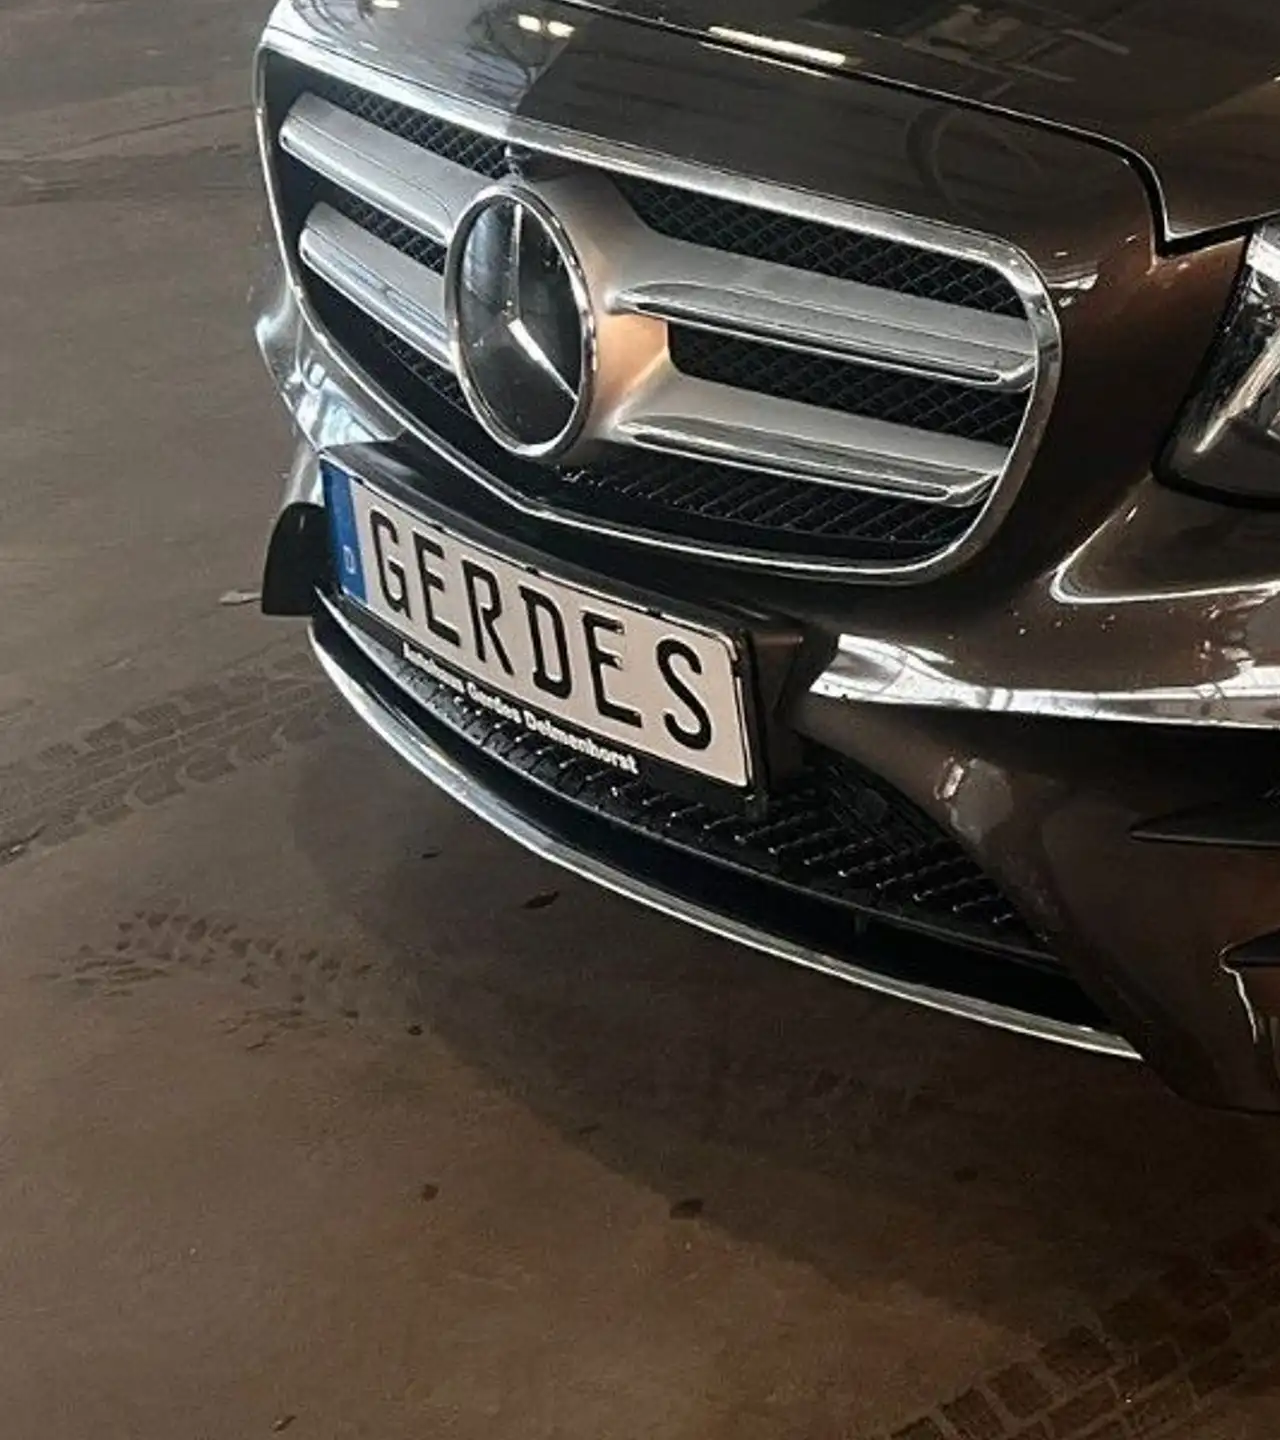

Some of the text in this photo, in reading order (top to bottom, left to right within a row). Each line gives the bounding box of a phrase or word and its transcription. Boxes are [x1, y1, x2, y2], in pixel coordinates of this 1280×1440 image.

[343, 544, 357, 574] D
[369, 510, 712, 751] GERDES
[523, 710, 639, 775] Delmenhorst
